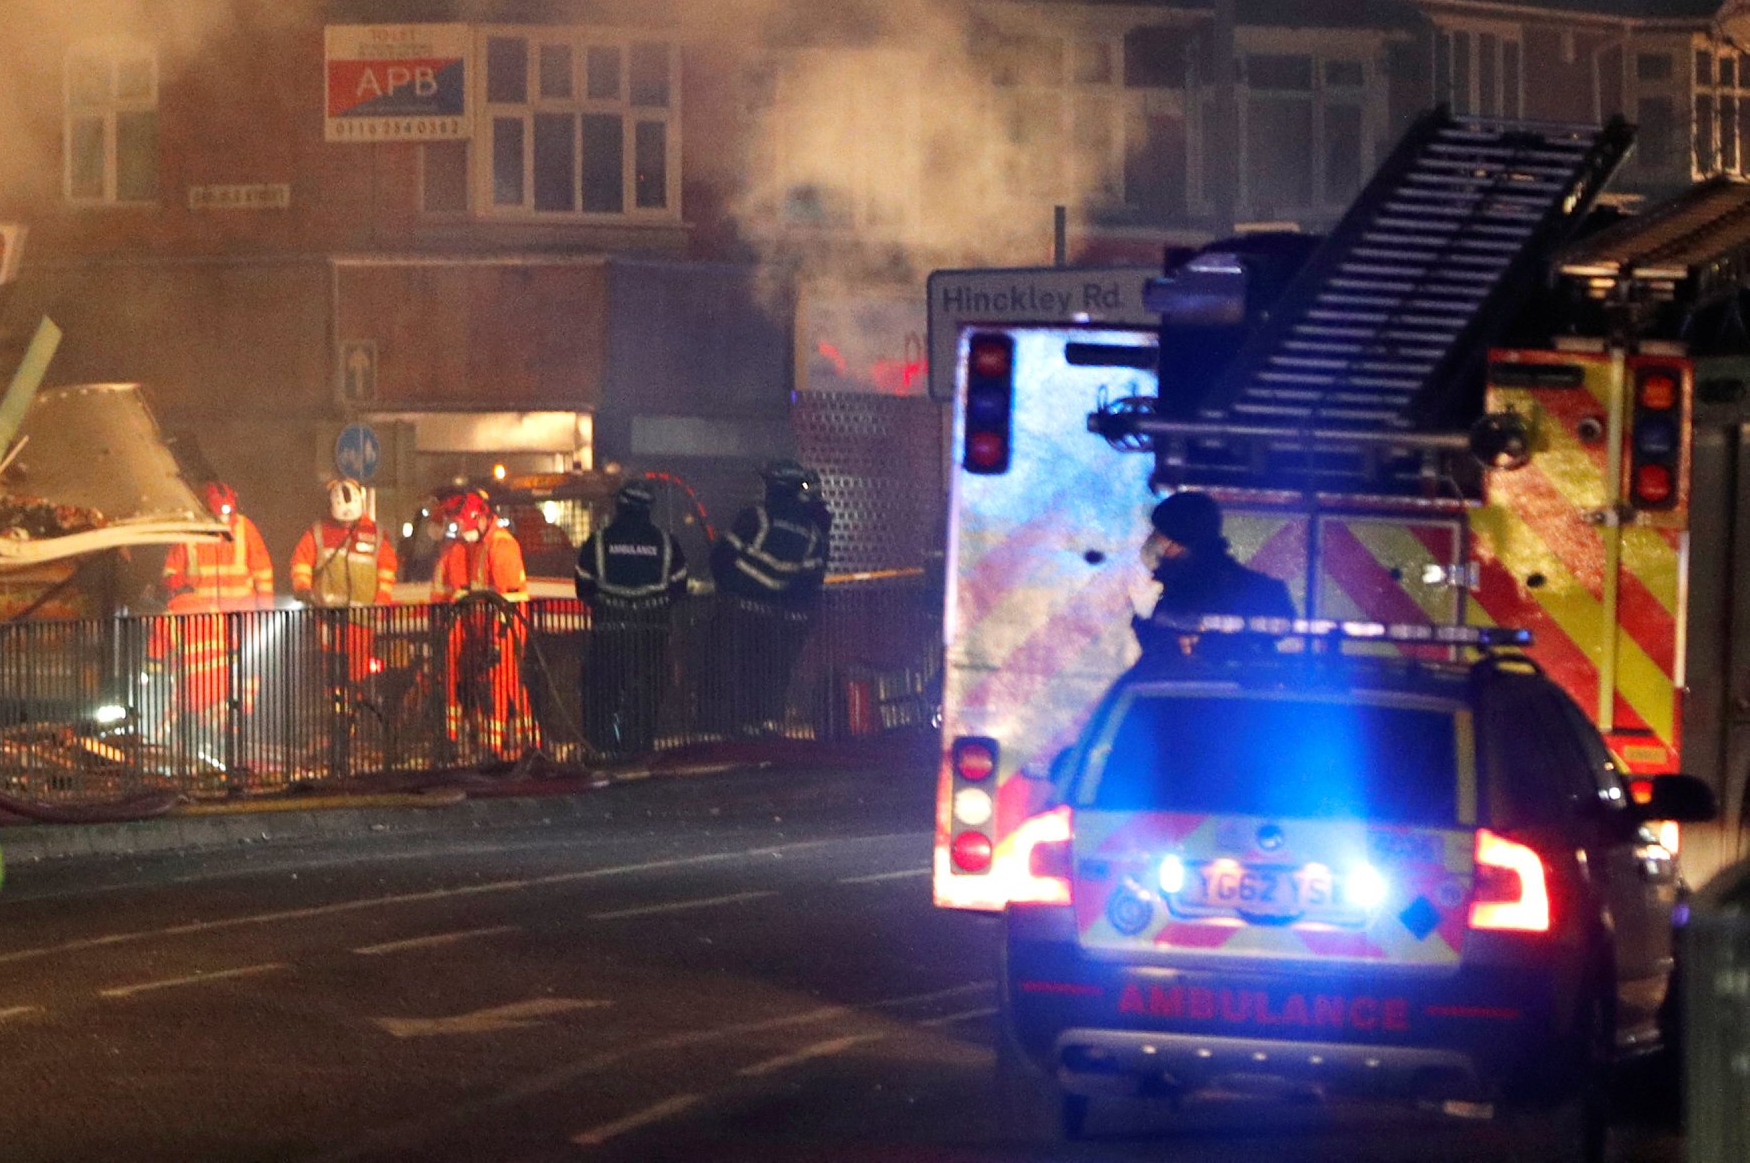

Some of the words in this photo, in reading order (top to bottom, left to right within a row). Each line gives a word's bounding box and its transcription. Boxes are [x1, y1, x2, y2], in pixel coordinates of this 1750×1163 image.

[355, 66, 439, 98] APB
[942, 286, 1073, 314] Hinckley
[1081, 283, 1121, 309] Rd
[608, 544, 658, 556] AMBULANCE
[1117, 982, 1411, 1031] AMBULANCE
